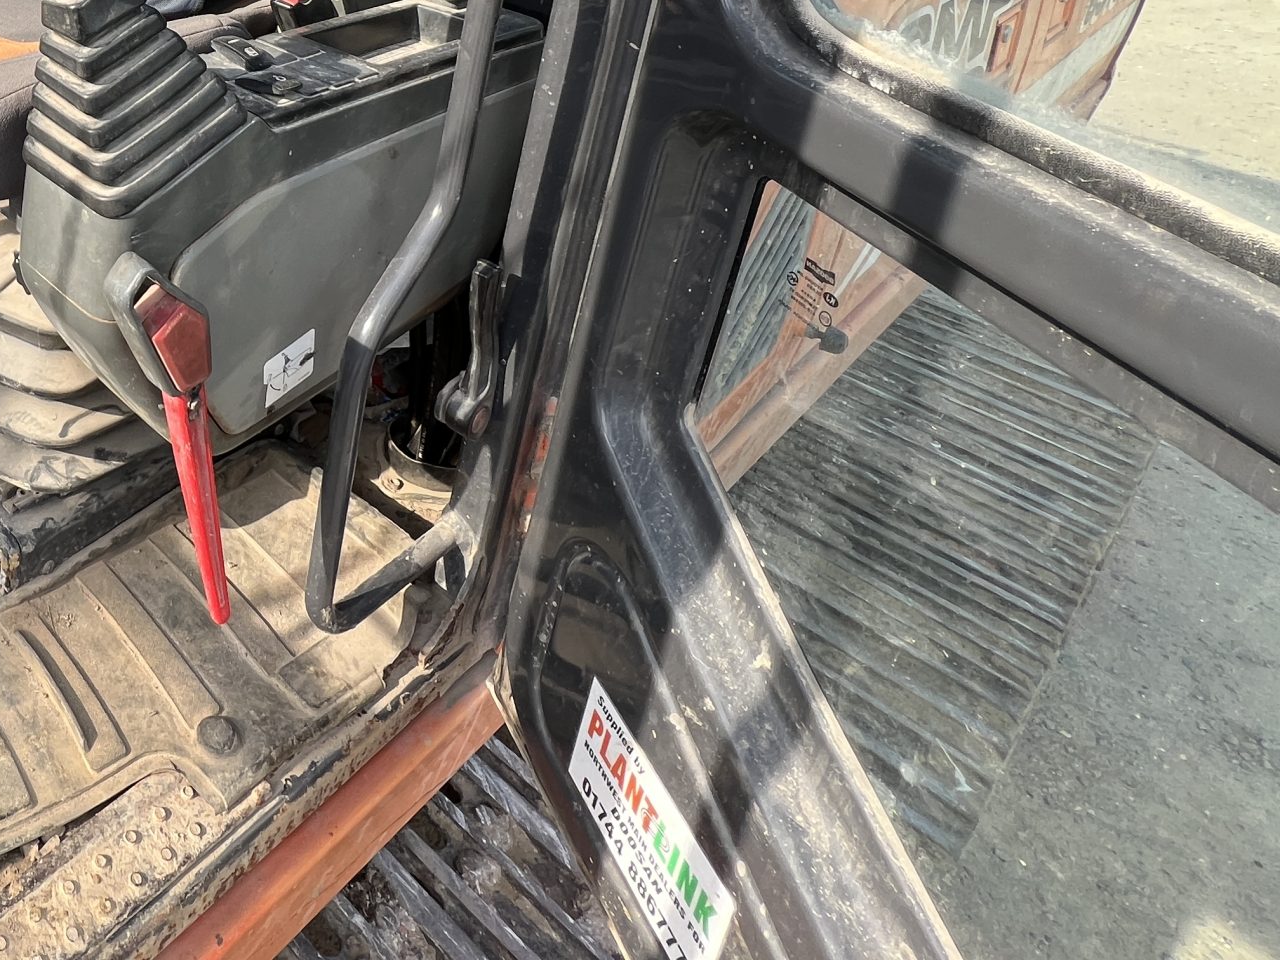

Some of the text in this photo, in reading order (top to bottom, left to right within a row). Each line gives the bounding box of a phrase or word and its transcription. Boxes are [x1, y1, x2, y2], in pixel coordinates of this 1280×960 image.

[597, 695, 645, 774] Supplied by
[582, 777, 623, 856] 01744
[584, 740, 705, 954] NORTHWEST MAIN DEALERS FOR
[610, 807, 662, 895] DOOSAN
